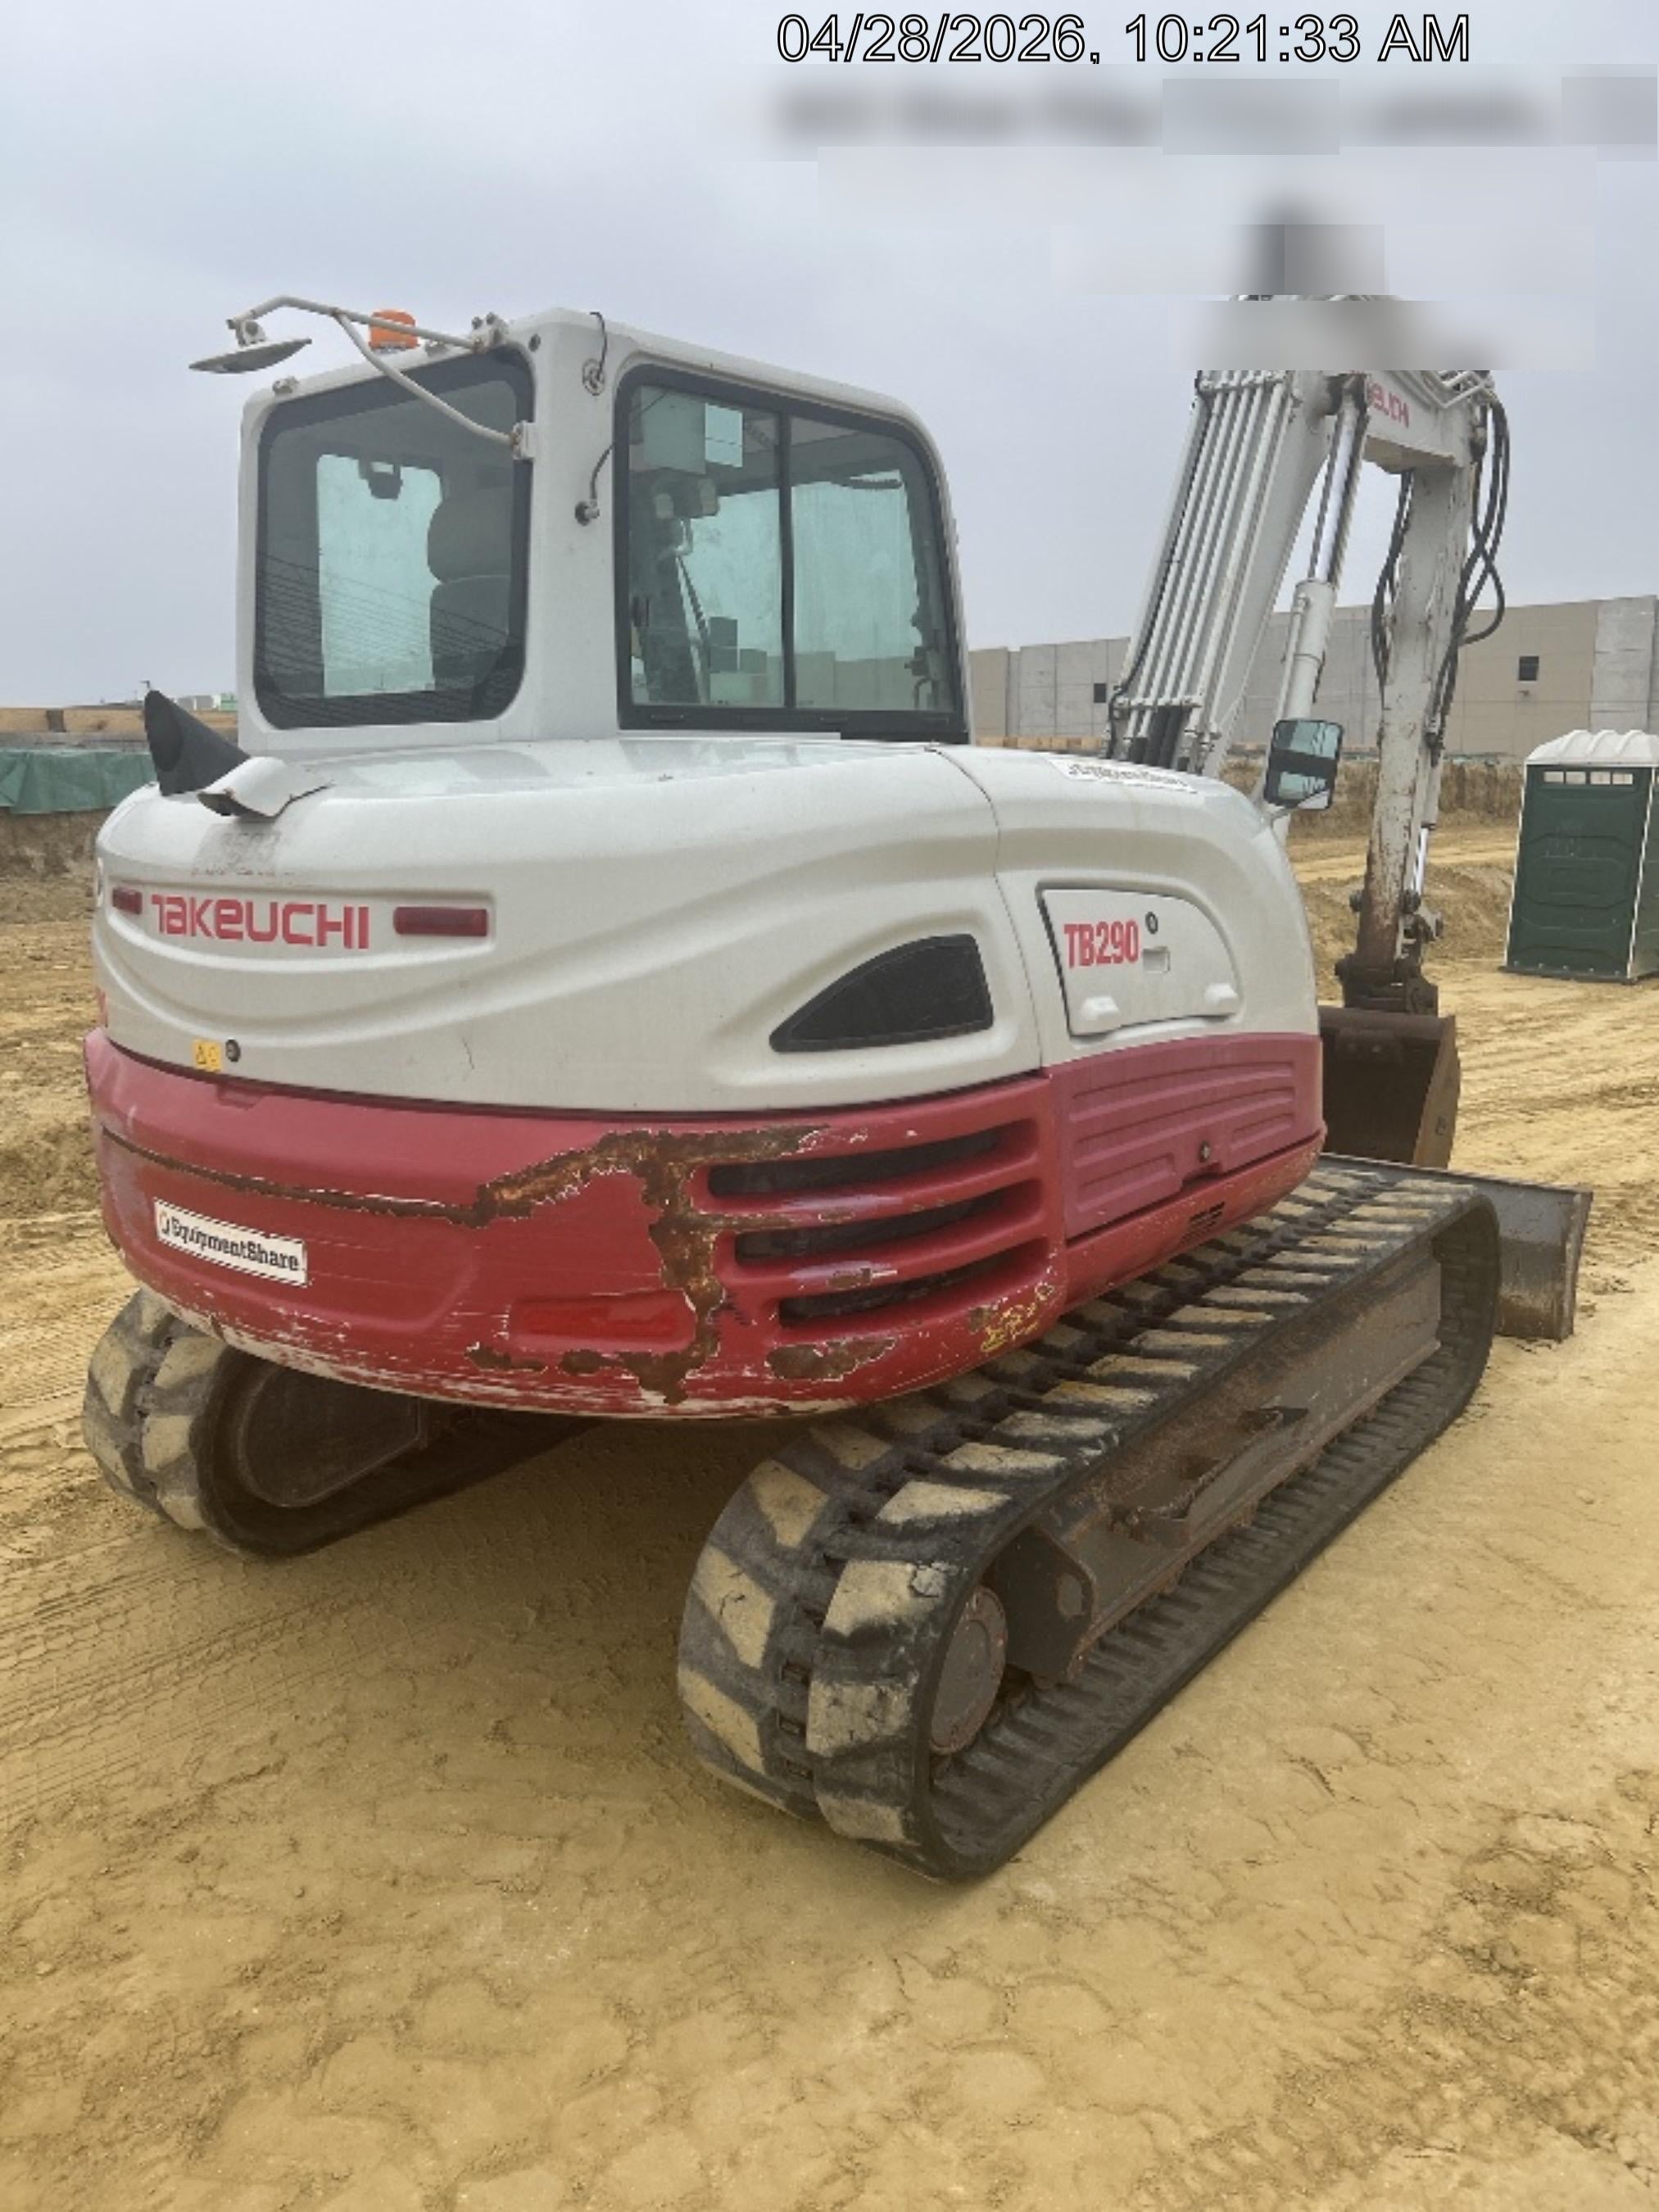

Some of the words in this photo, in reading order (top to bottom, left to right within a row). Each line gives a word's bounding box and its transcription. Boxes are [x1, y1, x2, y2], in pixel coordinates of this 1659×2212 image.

[152, 895, 369, 950] TAKEUCHI
[1063, 919, 1140, 968] TB290
[171, 1216, 299, 1271] EquipmentShare
